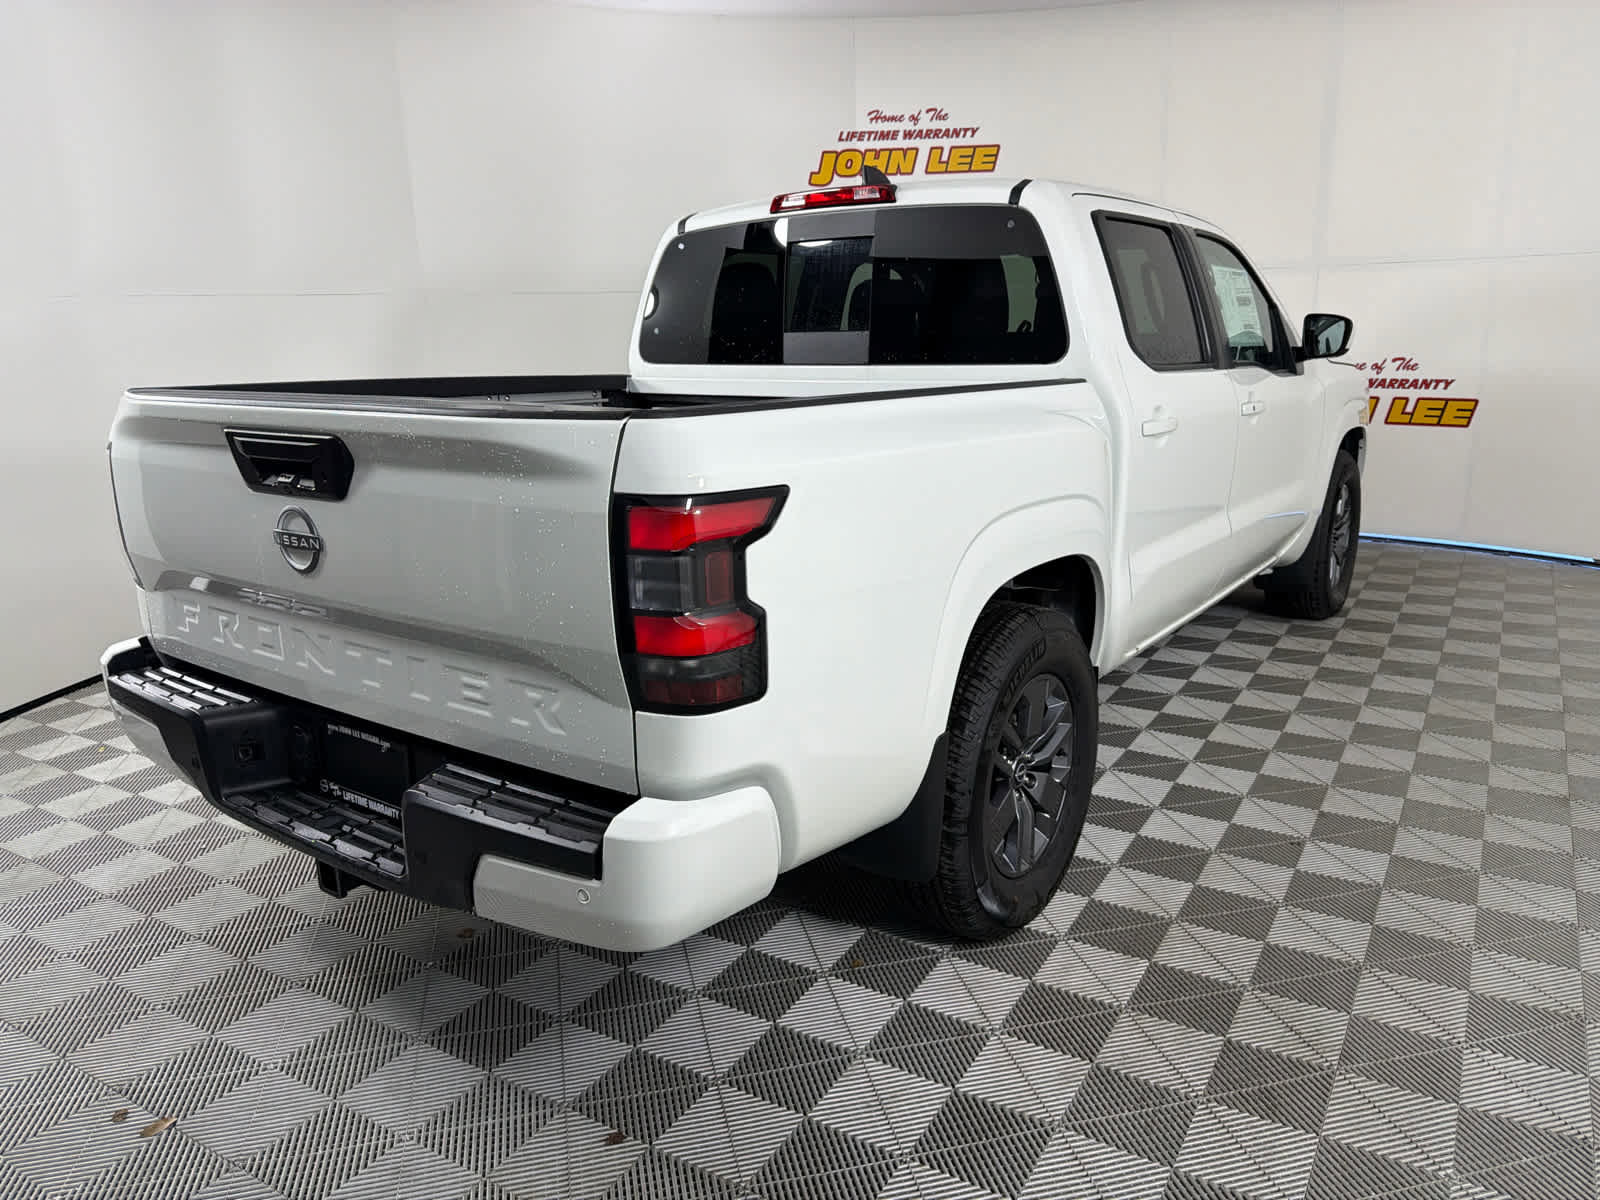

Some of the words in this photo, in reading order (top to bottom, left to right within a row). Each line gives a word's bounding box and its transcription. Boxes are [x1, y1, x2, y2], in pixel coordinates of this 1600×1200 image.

[867, 109, 905, 124] Home
[908, 110, 922, 126] of
[926, 107, 949, 122] The
[838, 130, 899, 142] LIFETIME
[903, 127, 980, 140] WARRANTY
[808, 147, 919, 187] JOHN
[925, 144, 1001, 174] LEE
[1370, 358, 1387, 375] of
[1392, 357, 1420, 372] The
[1384, 396, 1479, 428] LEE
[273, 532, 320, 550] NISSAN
[177, 600, 567, 736] FRONTIER
[342, 790, 368, 808] LIFETIME
[368, 799, 400, 819] WARRANTY
